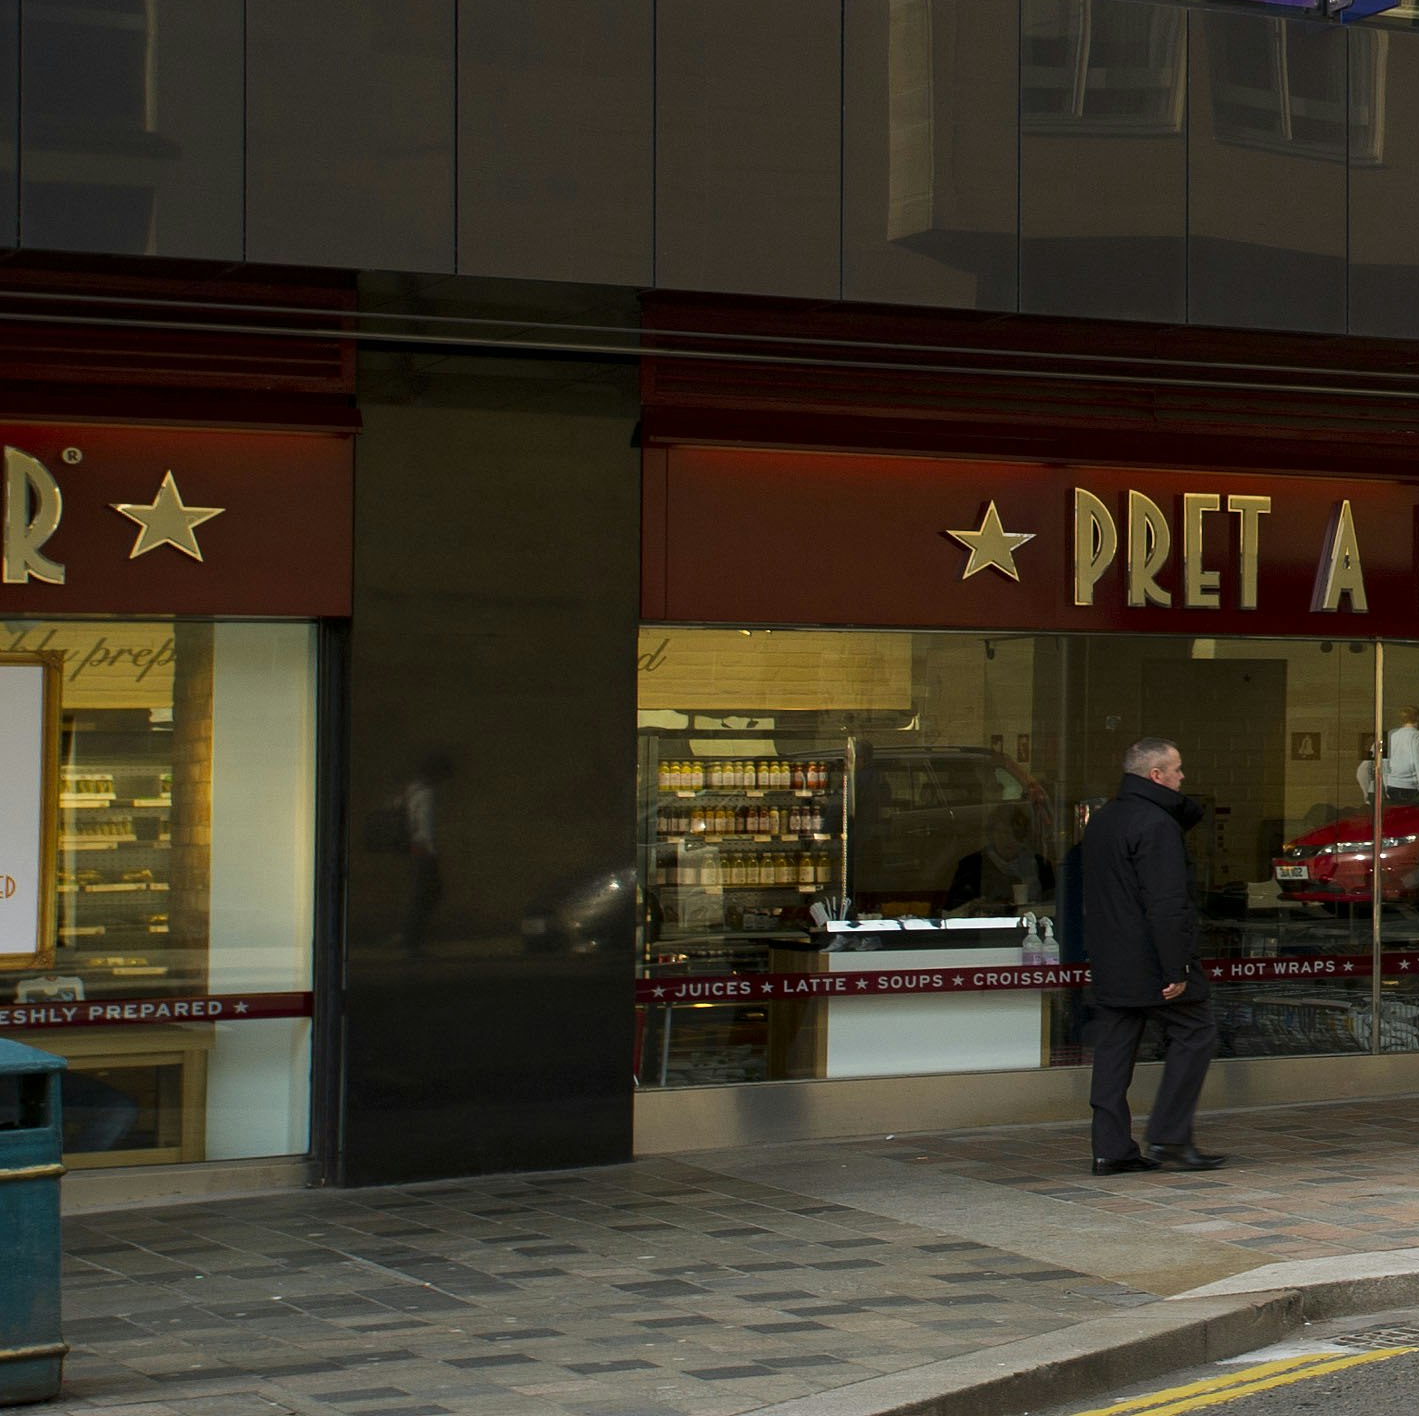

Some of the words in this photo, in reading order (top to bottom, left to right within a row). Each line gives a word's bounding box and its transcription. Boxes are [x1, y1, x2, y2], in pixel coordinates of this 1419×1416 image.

[1073, 486, 1272, 611] PRET
[1316, 499, 1370, 614] A
[1231, 962, 1267, 977] HOT
[1273, 960, 1336, 975] WRAPS
[674, 981, 752, 998] JUICES
[783, 977, 847, 994] LATTE
[877, 974, 944, 990] SOUPS
[973, 970, 1092, 986] CROISSANTS
[88, 999, 223, 1021] PREPARED
